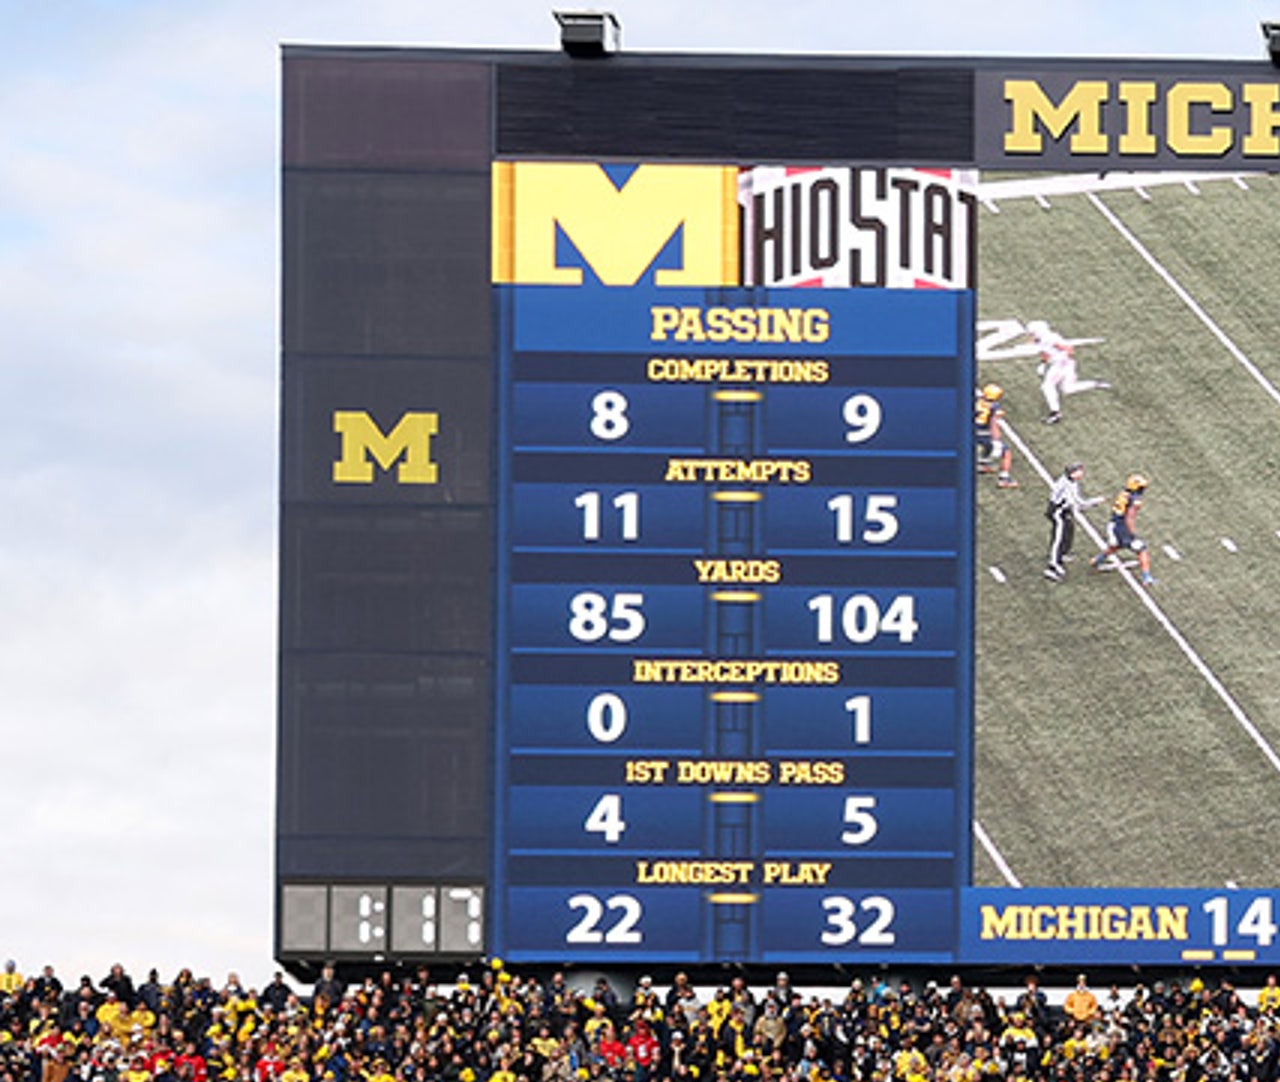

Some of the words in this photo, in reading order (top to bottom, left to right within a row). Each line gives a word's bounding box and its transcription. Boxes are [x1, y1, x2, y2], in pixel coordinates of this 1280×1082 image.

[650, 307, 831, 344] PASSING
[647, 359, 829, 383] COMPLETIONS
[590, 392, 629, 439] 8
[841, 394, 882, 442] 9
[332, 411, 439, 483] M
[665, 460, 812, 484] ATTEMPTS
[574, 494, 639, 540] 11
[828, 496, 899, 542] 15
[694, 560, 782, 583] YARDS
[569, 593, 645, 642] 85
[808, 595, 918, 643] 104
[632, 660, 841, 683] INTERCEPTIONS
[586, 693, 628, 742] 0
[845, 696, 872, 744] 1
[625, 761, 670, 782] 1ST
[677, 761, 771, 783] DOWNS
[779, 763, 845, 784] PASS
[584, 793, 626, 842] 4
[841, 796, 878, 844] 5
[636, 861, 754, 884] LONGEST
[763, 862, 831, 885] PLAY
[359, 888, 481, 944] 1:17
[566, 894, 643, 943] 22
[820, 896, 896, 945] 32
[979, 906, 1188, 941] MICHIGAN
[1203, 898, 1278, 946] 14
